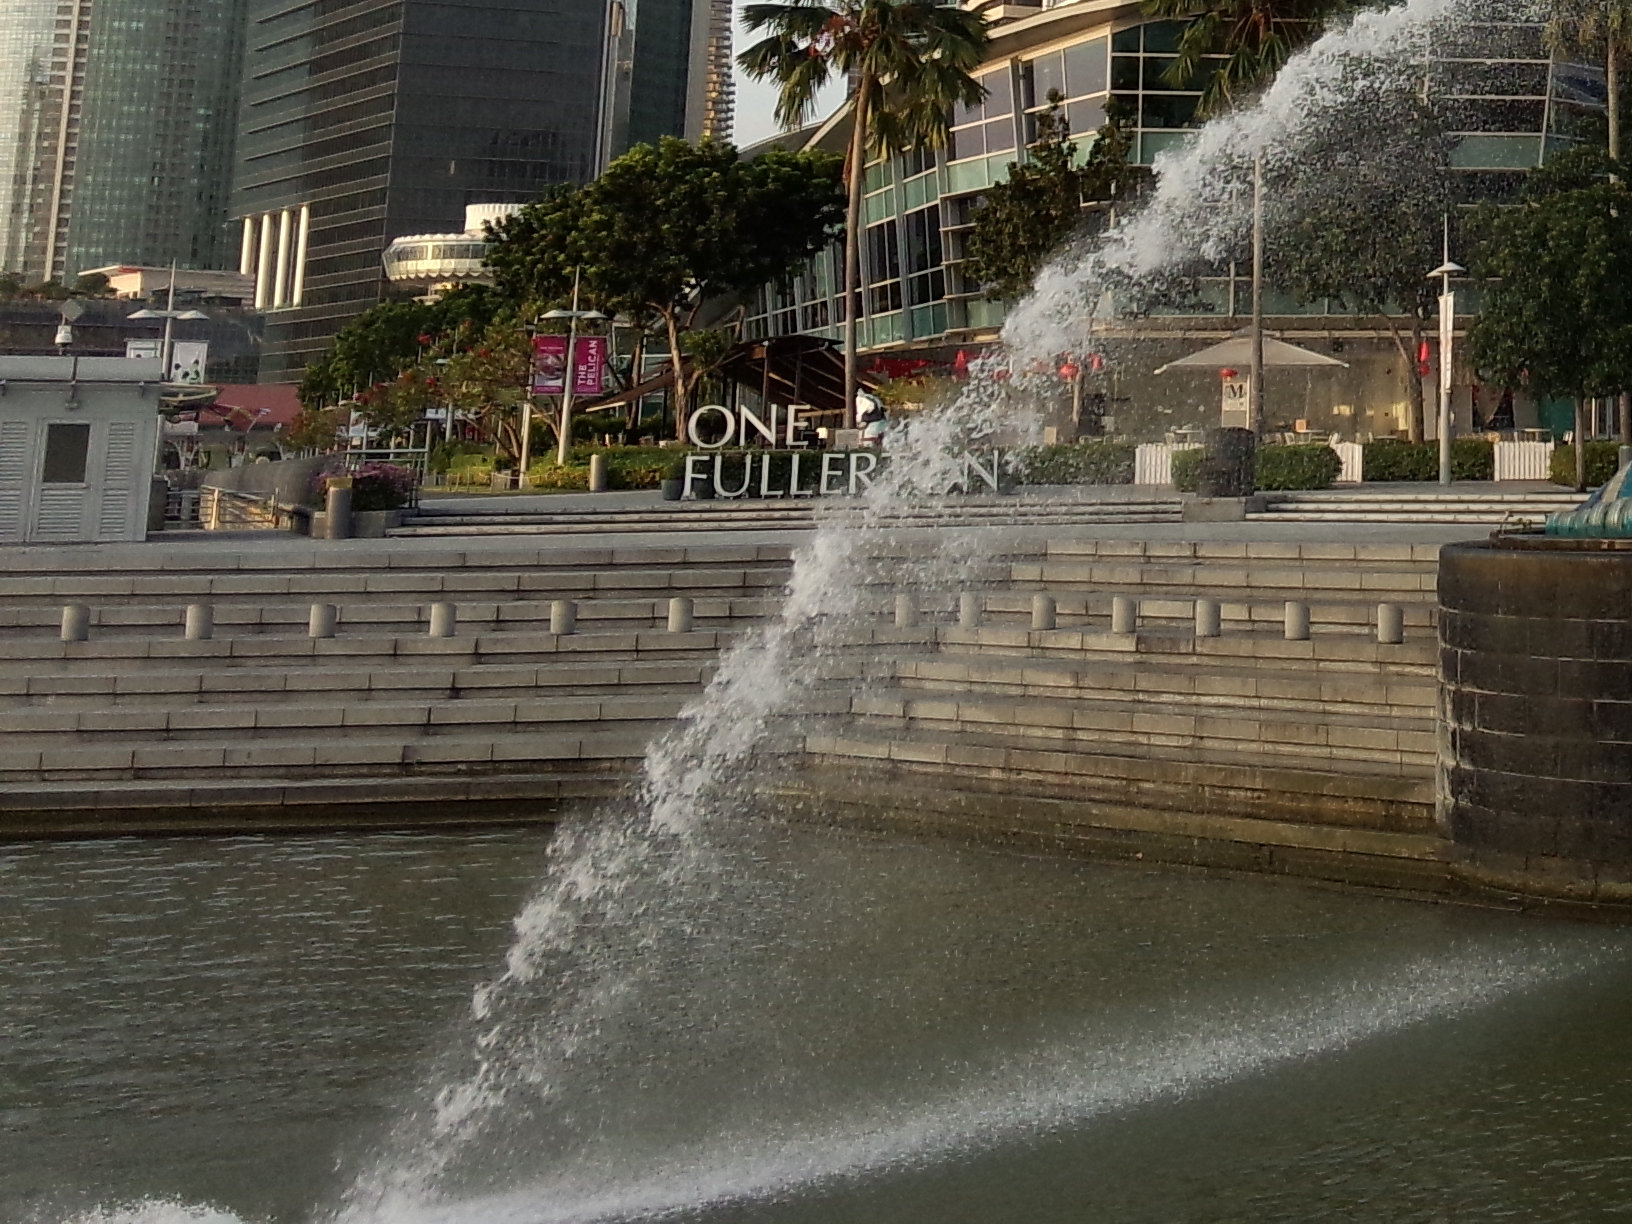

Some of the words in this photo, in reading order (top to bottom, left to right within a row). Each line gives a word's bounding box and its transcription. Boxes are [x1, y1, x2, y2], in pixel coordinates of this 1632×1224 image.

[577, 364, 587, 386] THE
[586, 340, 598, 386] PELICAN
[687, 403, 812, 450] ONE
[682, 449, 999, 499] FULLERN
